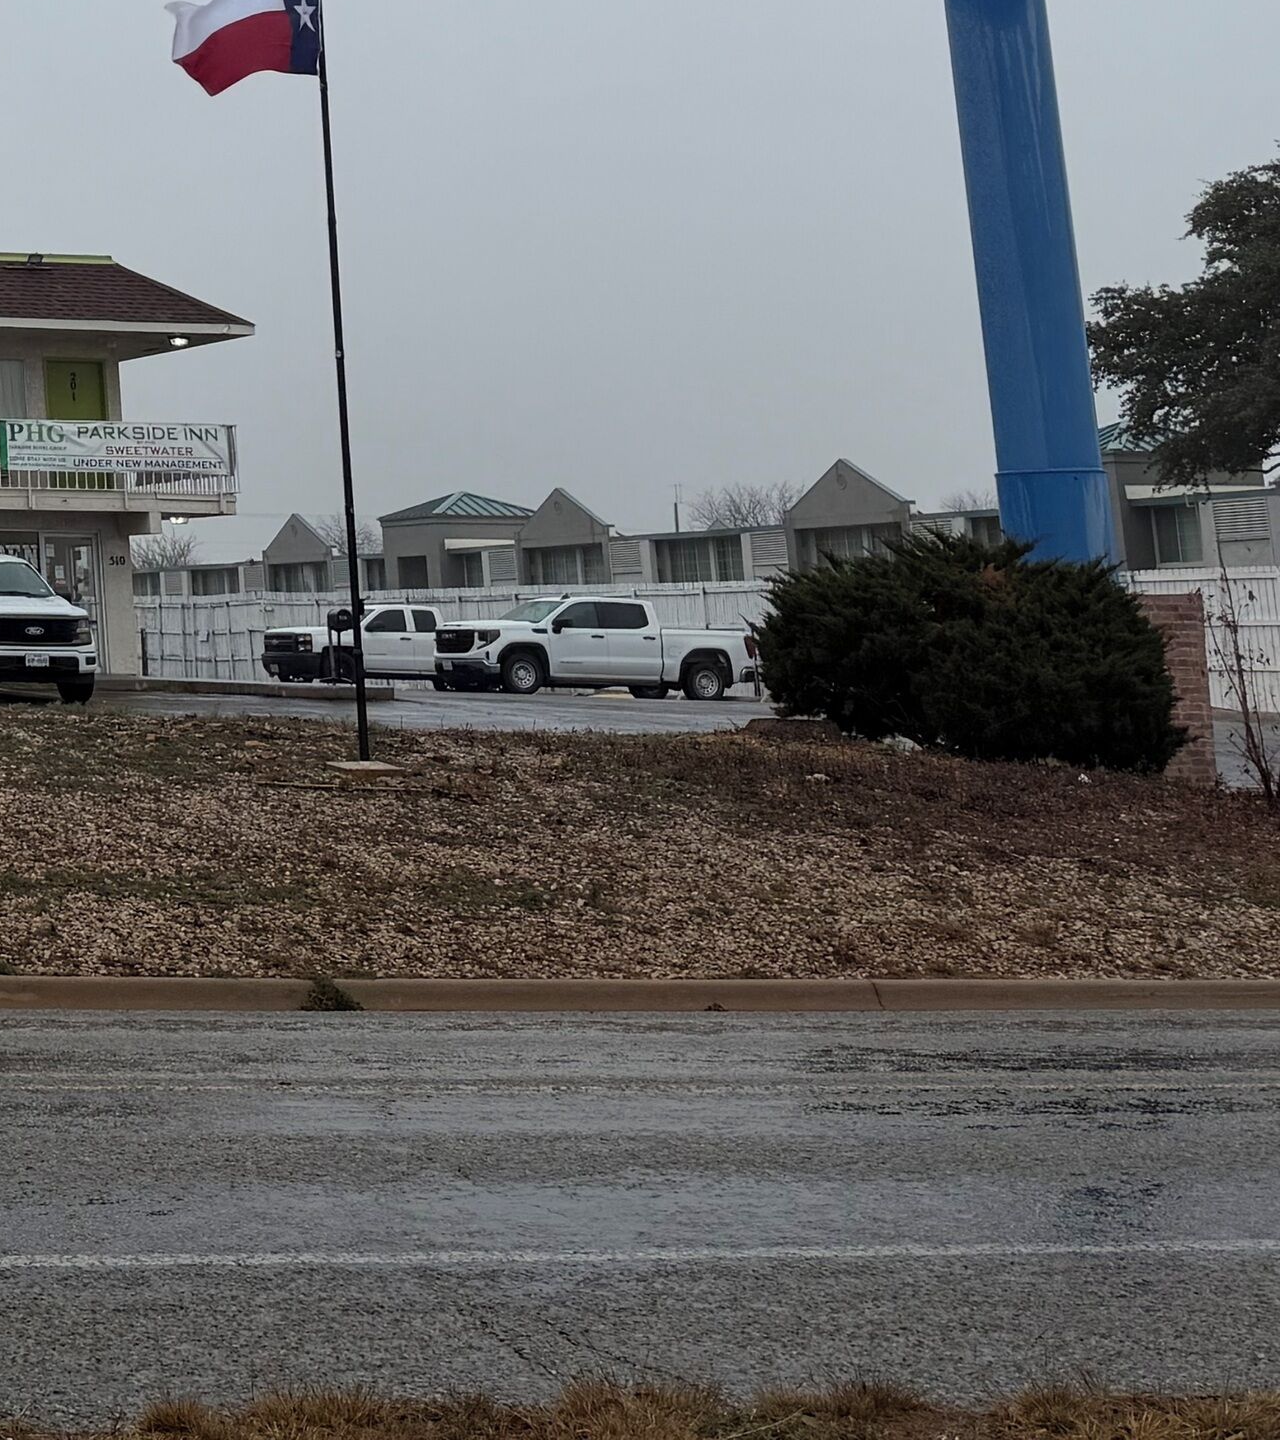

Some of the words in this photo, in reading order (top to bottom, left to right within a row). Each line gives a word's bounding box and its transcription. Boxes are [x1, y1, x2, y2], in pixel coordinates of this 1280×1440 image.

[7, 423, 66, 444] PHG
[76, 425, 179, 441] PARKSIDE
[183, 427, 218, 441] INN
[105, 445, 194, 457] SWEETWATER
[73, 458, 113, 468] UNDER
[116, 459, 142, 468] NEW
[144, 459, 224, 469] MANAGEMENT
[108, 556, 126, 566] 510
